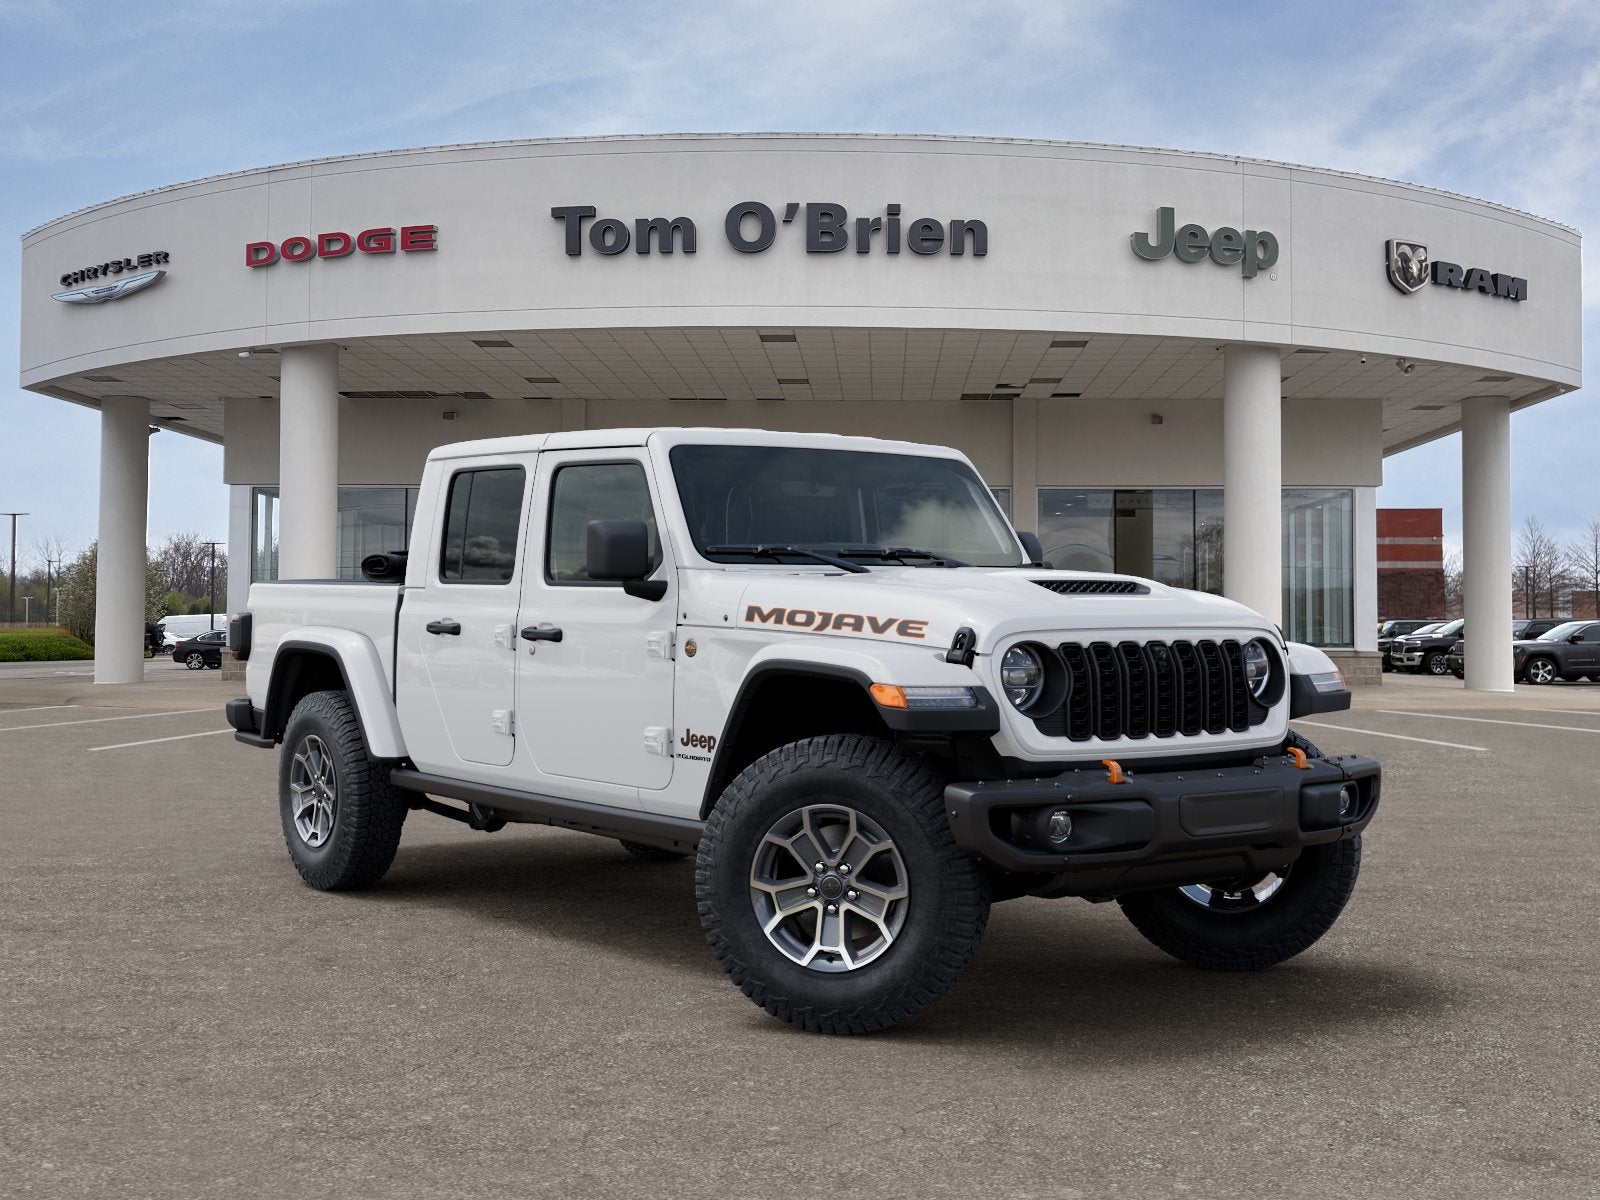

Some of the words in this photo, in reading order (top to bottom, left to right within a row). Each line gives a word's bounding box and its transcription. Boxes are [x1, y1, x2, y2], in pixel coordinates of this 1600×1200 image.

[245, 224, 439, 269] DODGE
[551, 205, 697, 257] Tom
[724, 201, 988, 257] O'Brien
[1131, 206, 1280, 279] Jeep
[60, 250, 170, 287] CHRYSLER
[1430, 260, 1528, 301] RAM
[744, 605, 929, 639] MOJAVE
[680, 728, 717, 754] Jeep
